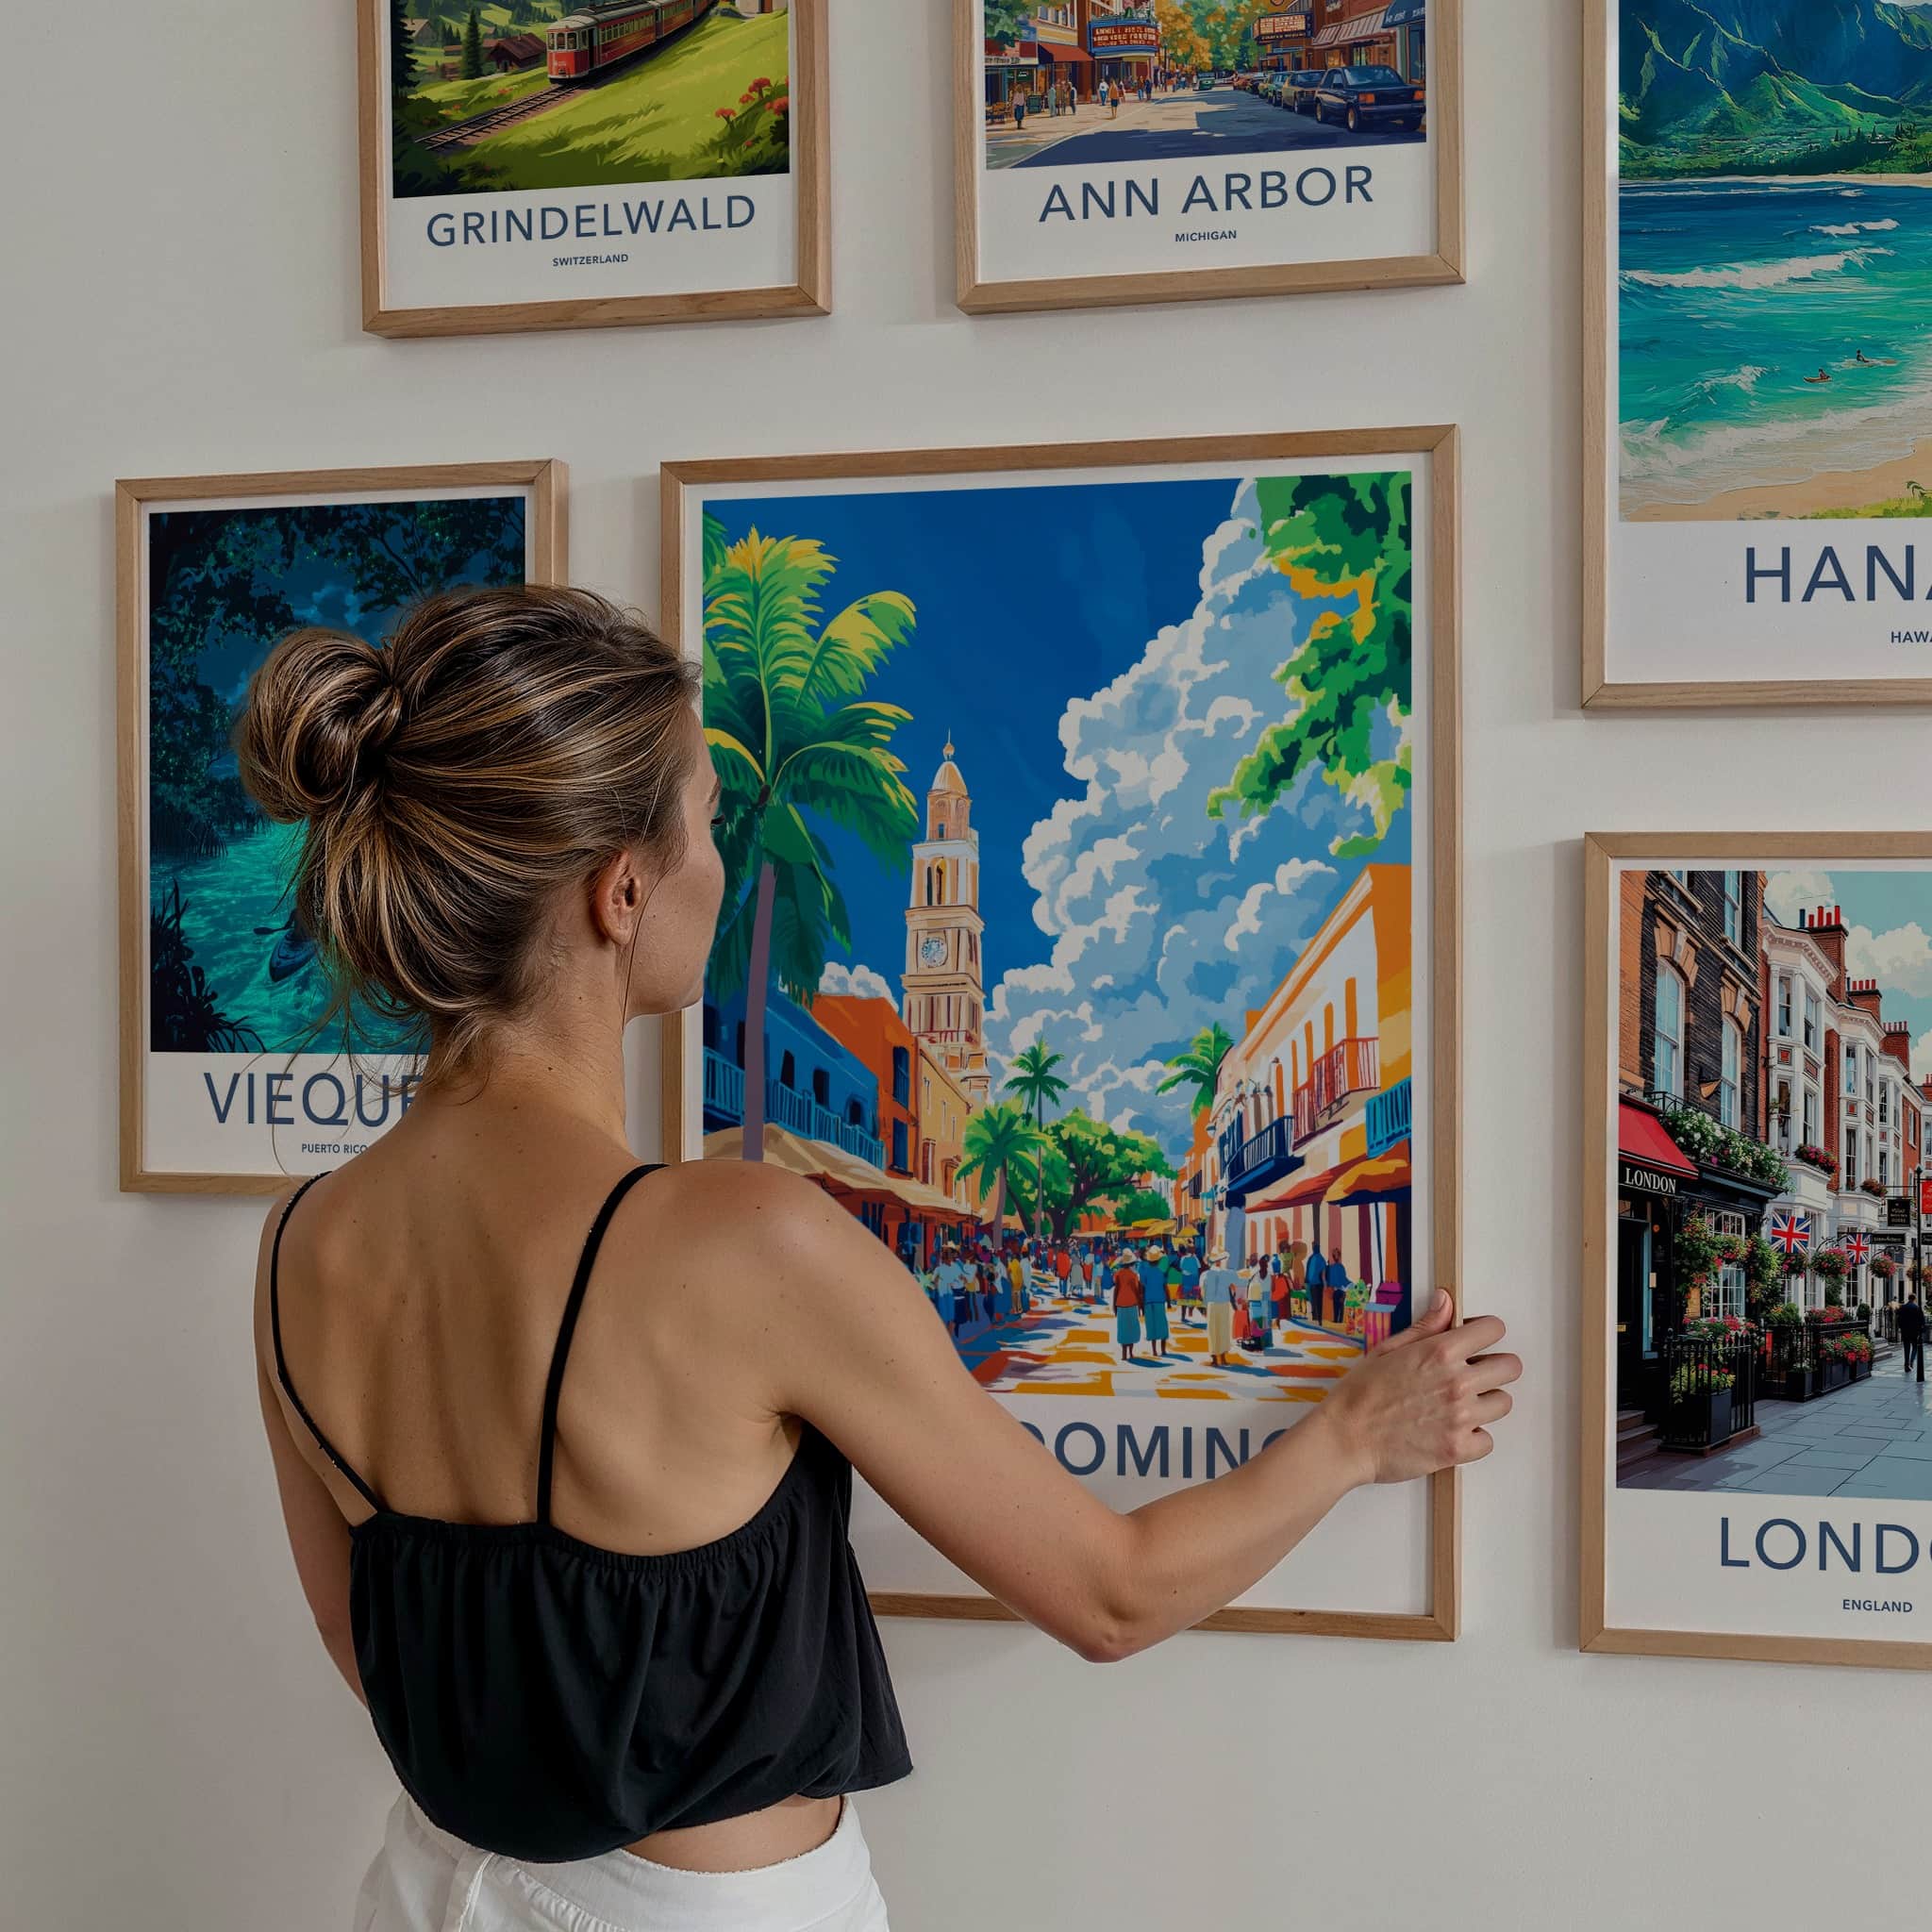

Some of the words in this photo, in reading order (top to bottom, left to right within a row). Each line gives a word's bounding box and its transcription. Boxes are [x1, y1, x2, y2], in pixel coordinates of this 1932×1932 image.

[1039, 178, 1158, 223] ANN
[1181, 165, 1374, 214] ARBOR
[426, 194, 756, 247] GRINDELWALD
[1174, 229, 1237, 242] MICHIGAN
[552, 254, 628, 267] SWITZERLAND
[1746, 544, 1932, 603] HAN
[1890, 630, 1932, 643] HAW
[301, 1142, 341, 1154] PUERTO
[343, 1143, 368, 1155] RICO
[1625, 1167, 1676, 1194] LONDON
[1019, 1421, 1290, 1479] OMIN
[1721, 1517, 1932, 1574] LOND
[1842, 1599, 1913, 1613] ENGLAND
